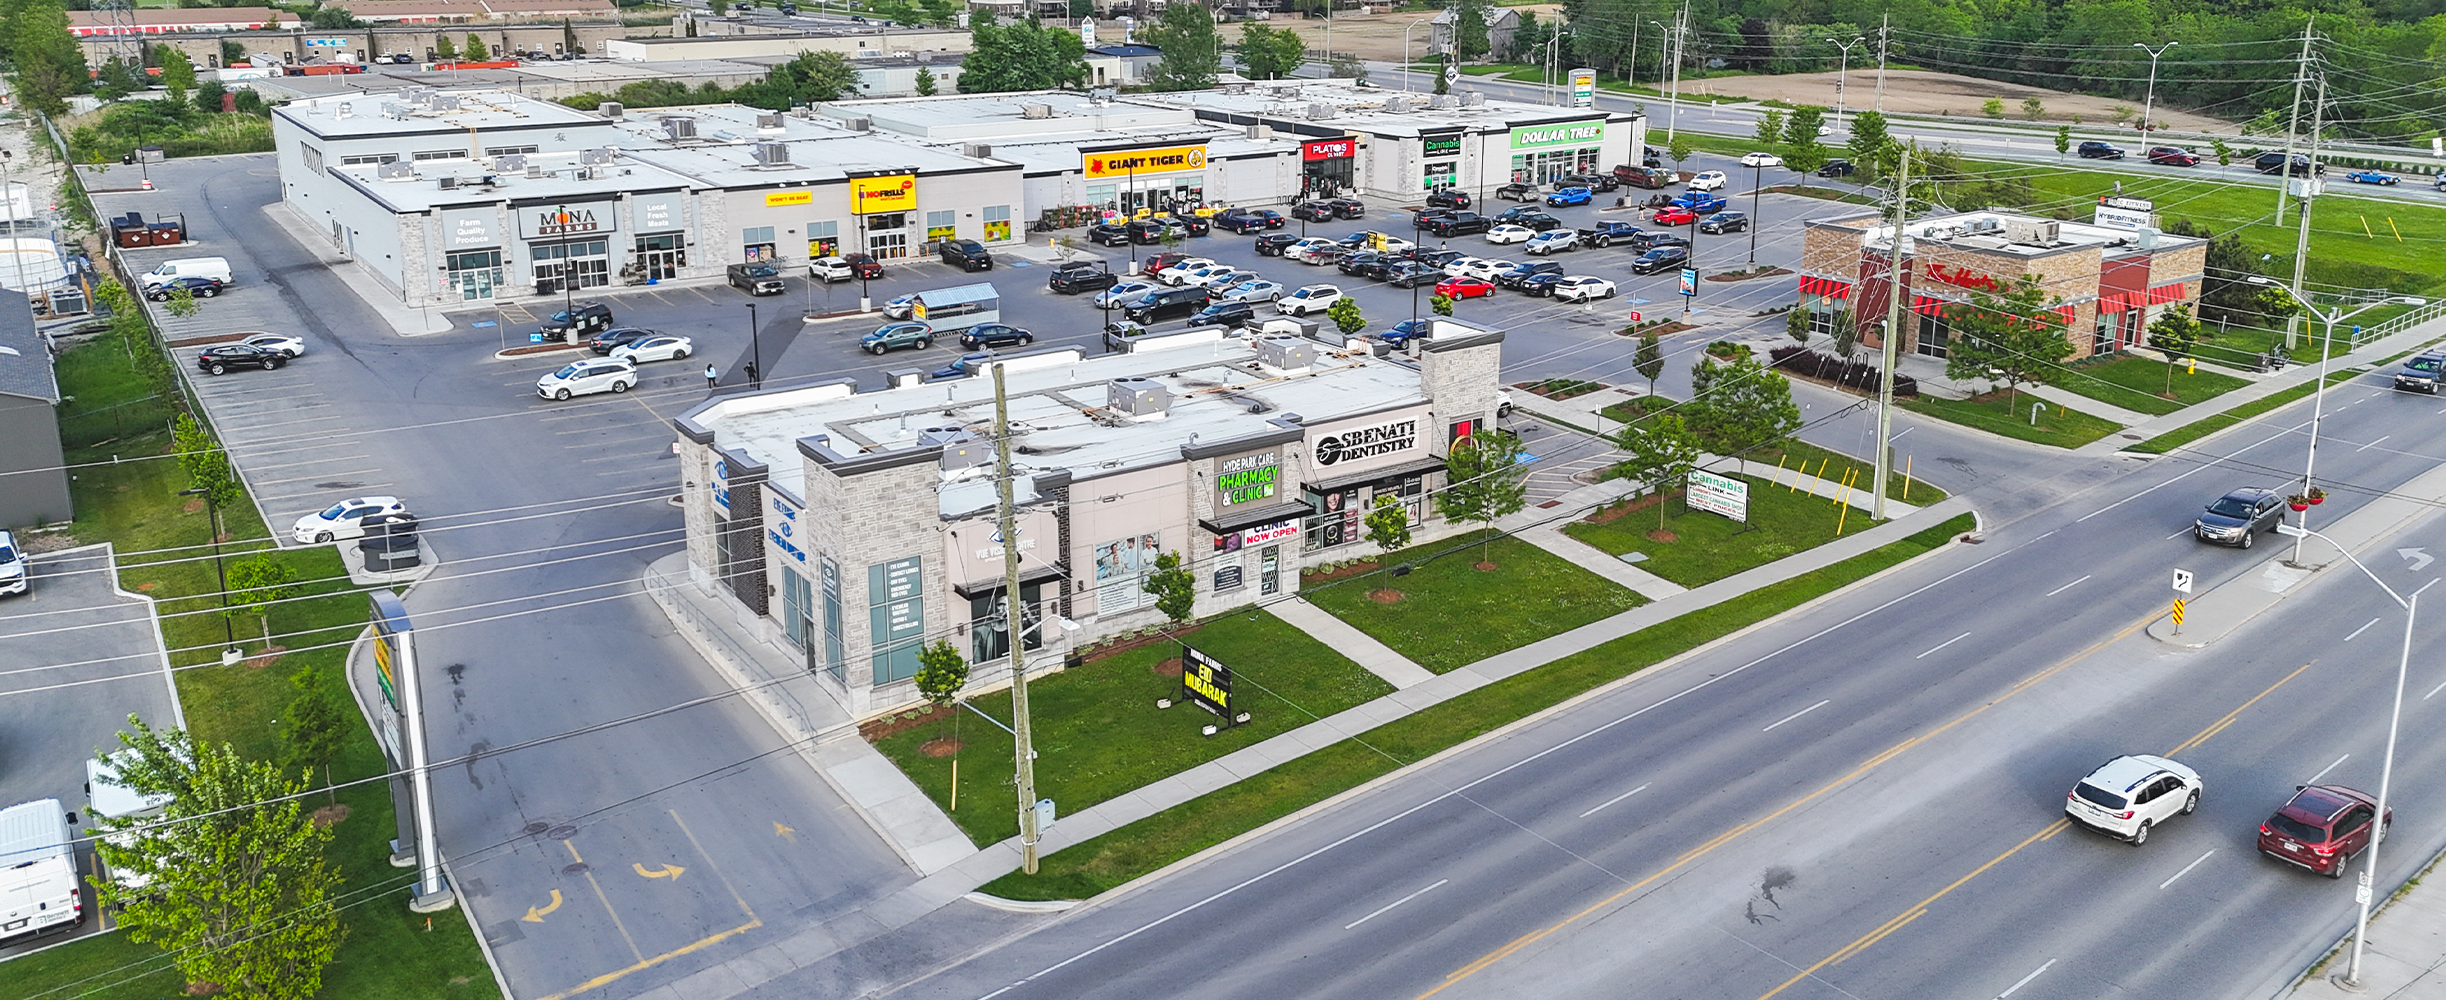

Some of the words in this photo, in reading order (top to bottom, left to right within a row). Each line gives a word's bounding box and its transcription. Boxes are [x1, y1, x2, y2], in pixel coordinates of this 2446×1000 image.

[1426, 138, 1460, 150] Cannabis
[1521, 129, 1565, 144] DOLLAR
[1569, 126, 1597, 139] TREE
[1108, 158, 1146, 170] GIANT
[1149, 154, 1184, 167] TIGER
[647, 203, 667, 212] Local
[647, 211, 669, 220] Fresh
[459, 219, 481, 227] Farm
[546, 223, 593, 234] FARMS
[647, 218, 669, 227] Meats
[455, 235, 489, 244] Produce
[457, 227, 486, 237] Quality
[1341, 420, 1415, 448] SBENATI
[1341, 436, 1415, 462] DENTISTRY
[1223, 459, 1240, 473] HYDE
[1241, 456, 1256, 470] PARK
[1258, 452, 1274, 466] CARE
[1218, 465, 1278, 491] PHARMACY
[1691, 470, 1743, 493] Cannabis
[1222, 491, 1231, 507] &
[1232, 485, 1262, 504] CLINIC
[1707, 485, 1724, 494] LINK
[1246, 531, 1270, 544] NOW
[1272, 526, 1297, 538] OPEN
[975, 548, 989, 560] VUE
[1016, 539, 1036, 551] ENTRE
[1198, 663, 1213, 683] EID
[1185, 670, 1228, 708] MUBARAK
